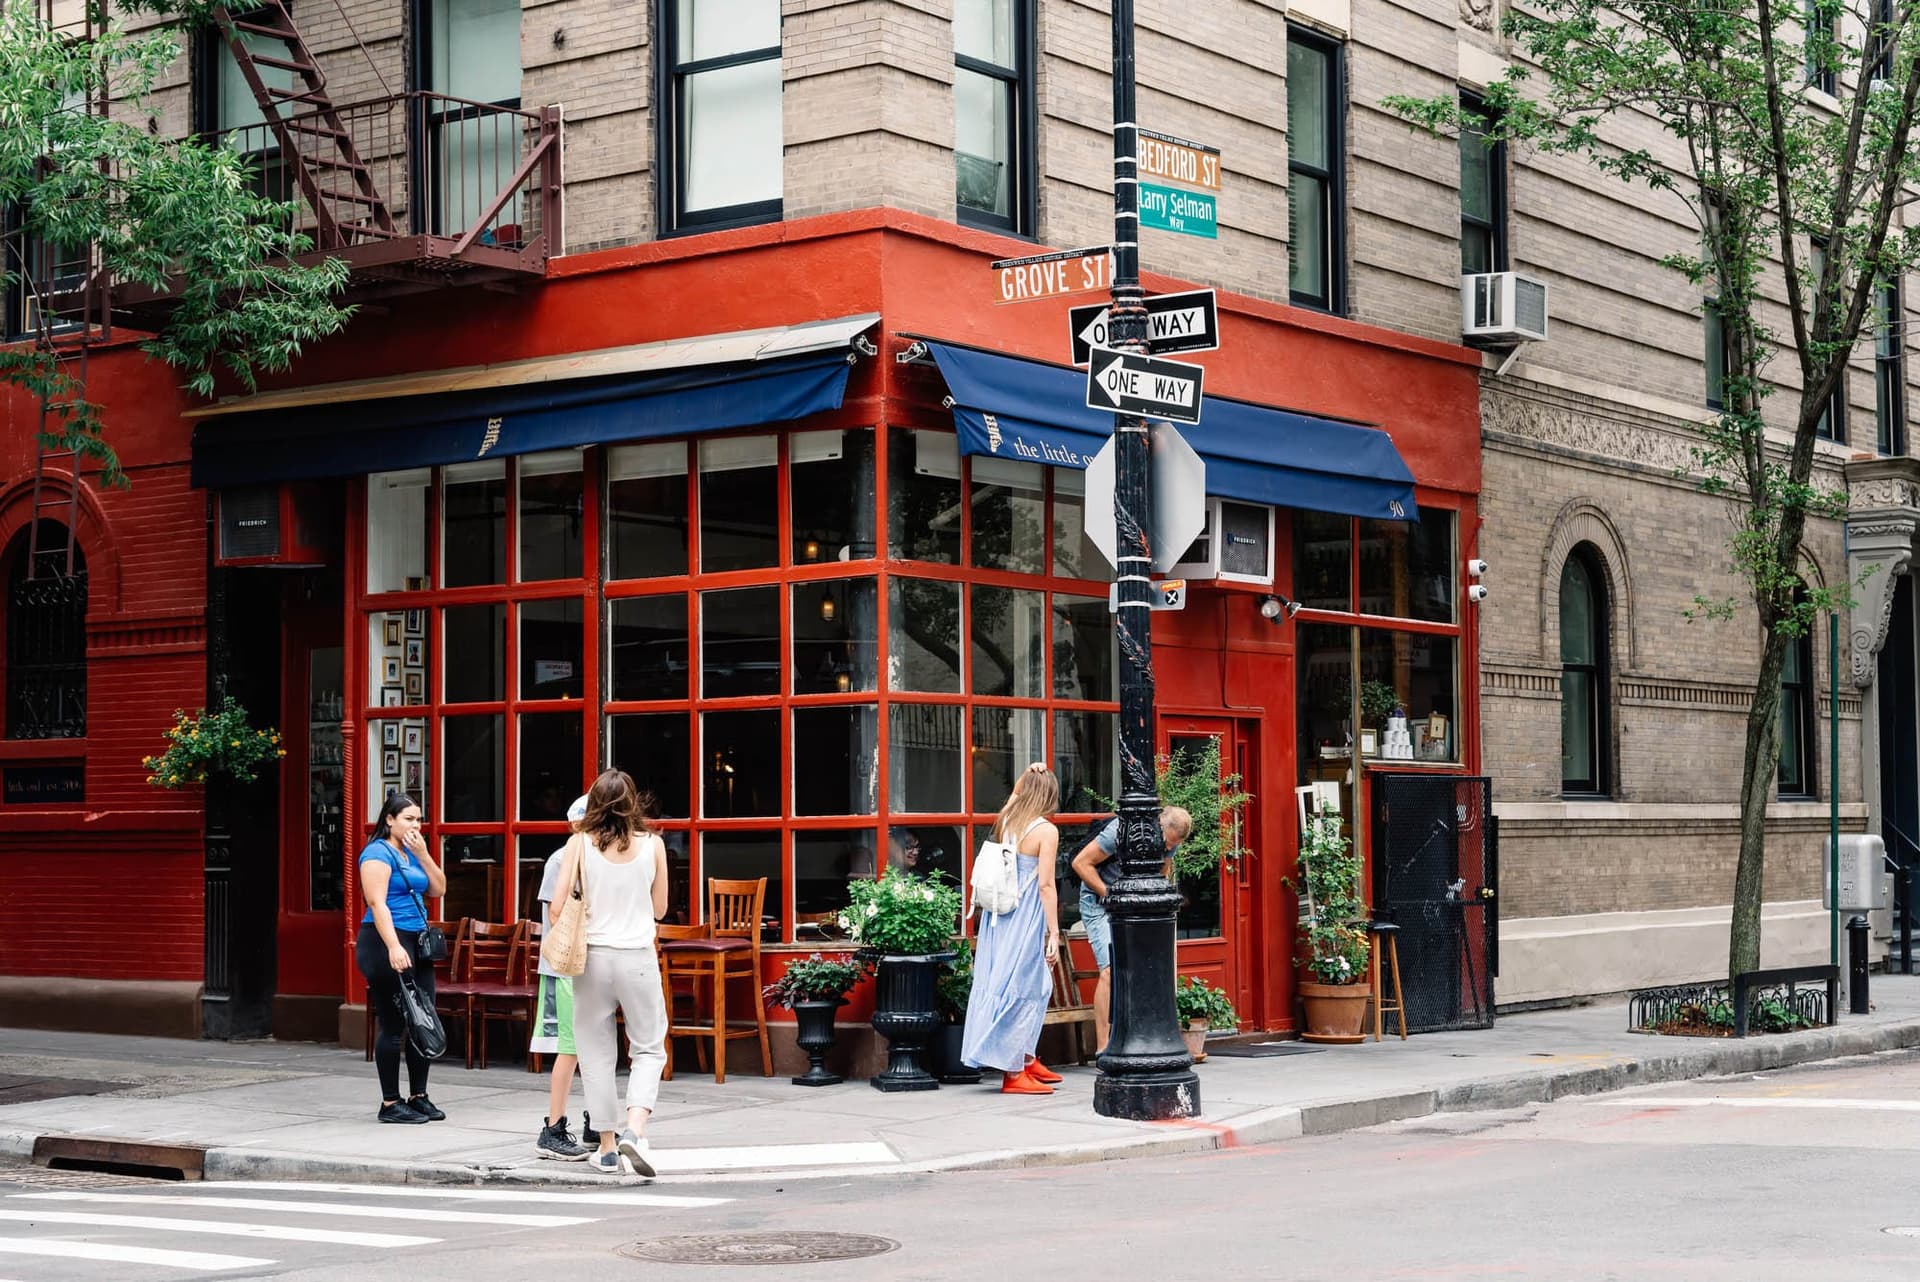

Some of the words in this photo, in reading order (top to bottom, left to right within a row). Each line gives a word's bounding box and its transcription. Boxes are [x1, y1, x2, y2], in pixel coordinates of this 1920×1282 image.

[1139, 138, 1197, 182] BEDFORD
[1202, 155, 1217, 187] ST
[1139, 186, 1167, 218] Larry
[1170, 192, 1213, 220] Selman
[1169, 216, 1184, 231] Way
[1001, 260, 1070, 300] GROVE
[1082, 255, 1104, 289] ST
[1152, 311, 1195, 337] WAY
[1107, 369, 1139, 395] ONE
[1155, 377, 1187, 403] WAY
[1014, 437, 1039, 457] the
[1040, 441, 1079, 464] little
[1390, 500, 1404, 517] 90
